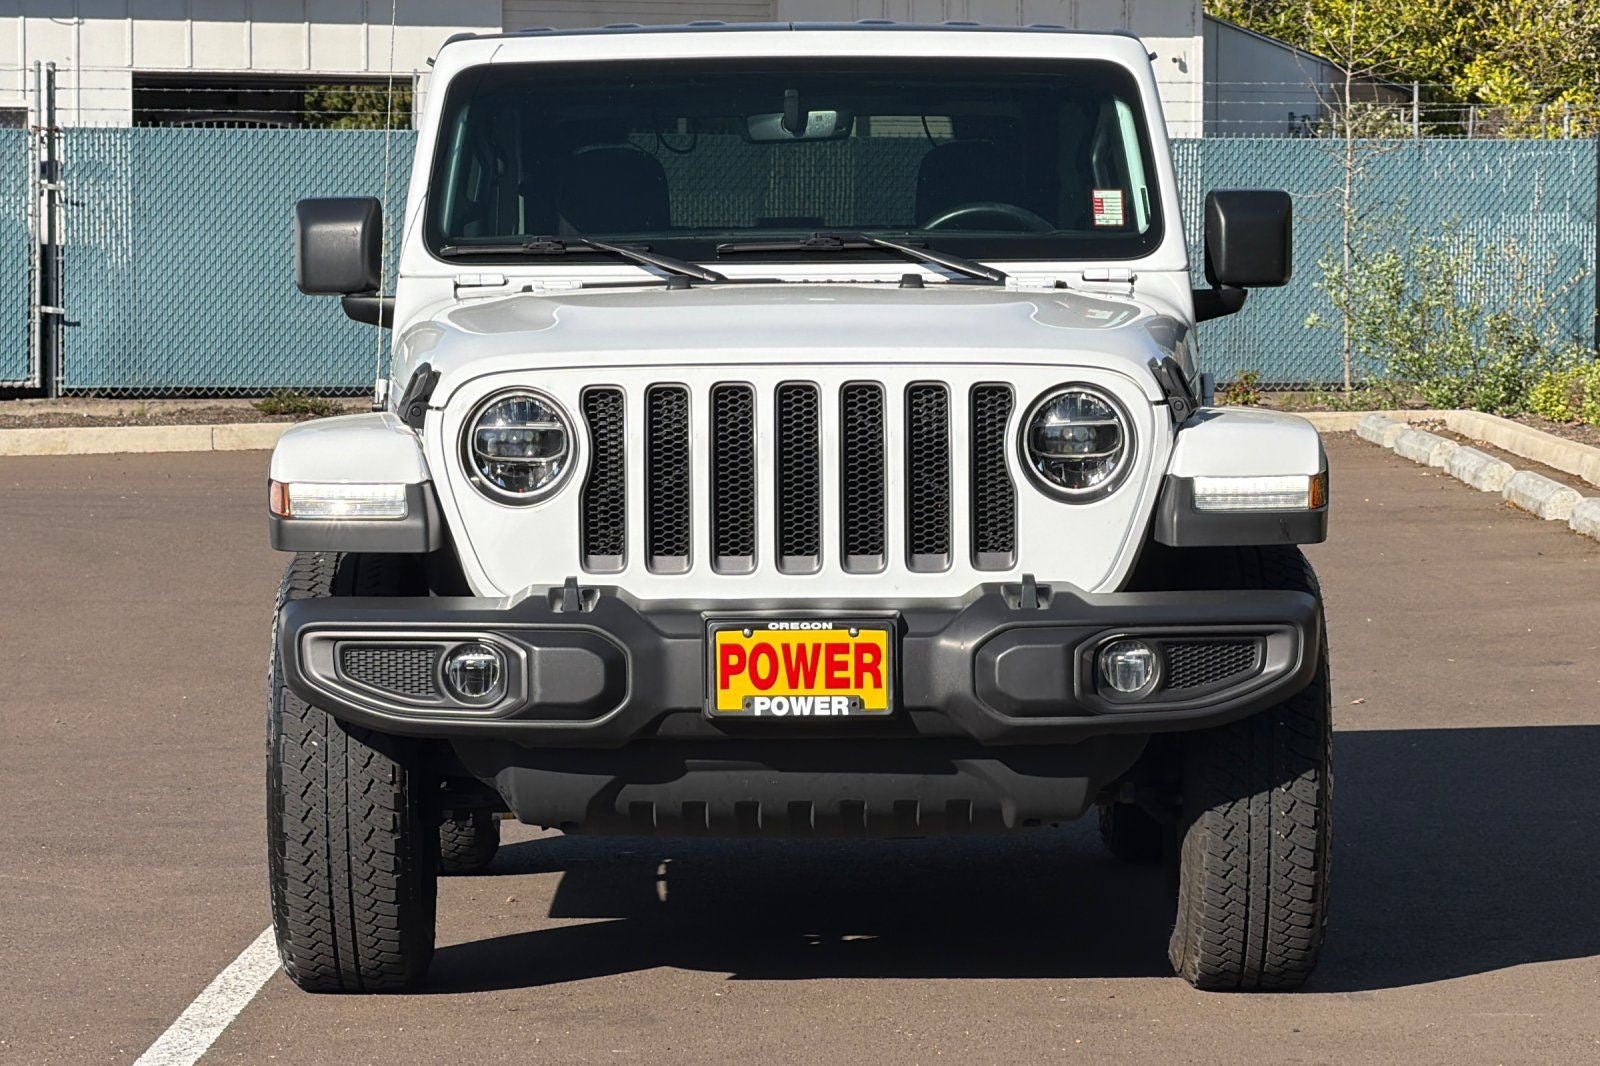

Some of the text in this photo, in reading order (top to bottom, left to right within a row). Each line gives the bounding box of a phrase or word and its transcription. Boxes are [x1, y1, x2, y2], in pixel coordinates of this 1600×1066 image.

[768, 622, 833, 630] OREGON
[720, 642, 883, 690] POWER
[754, 696, 849, 716] POWER
